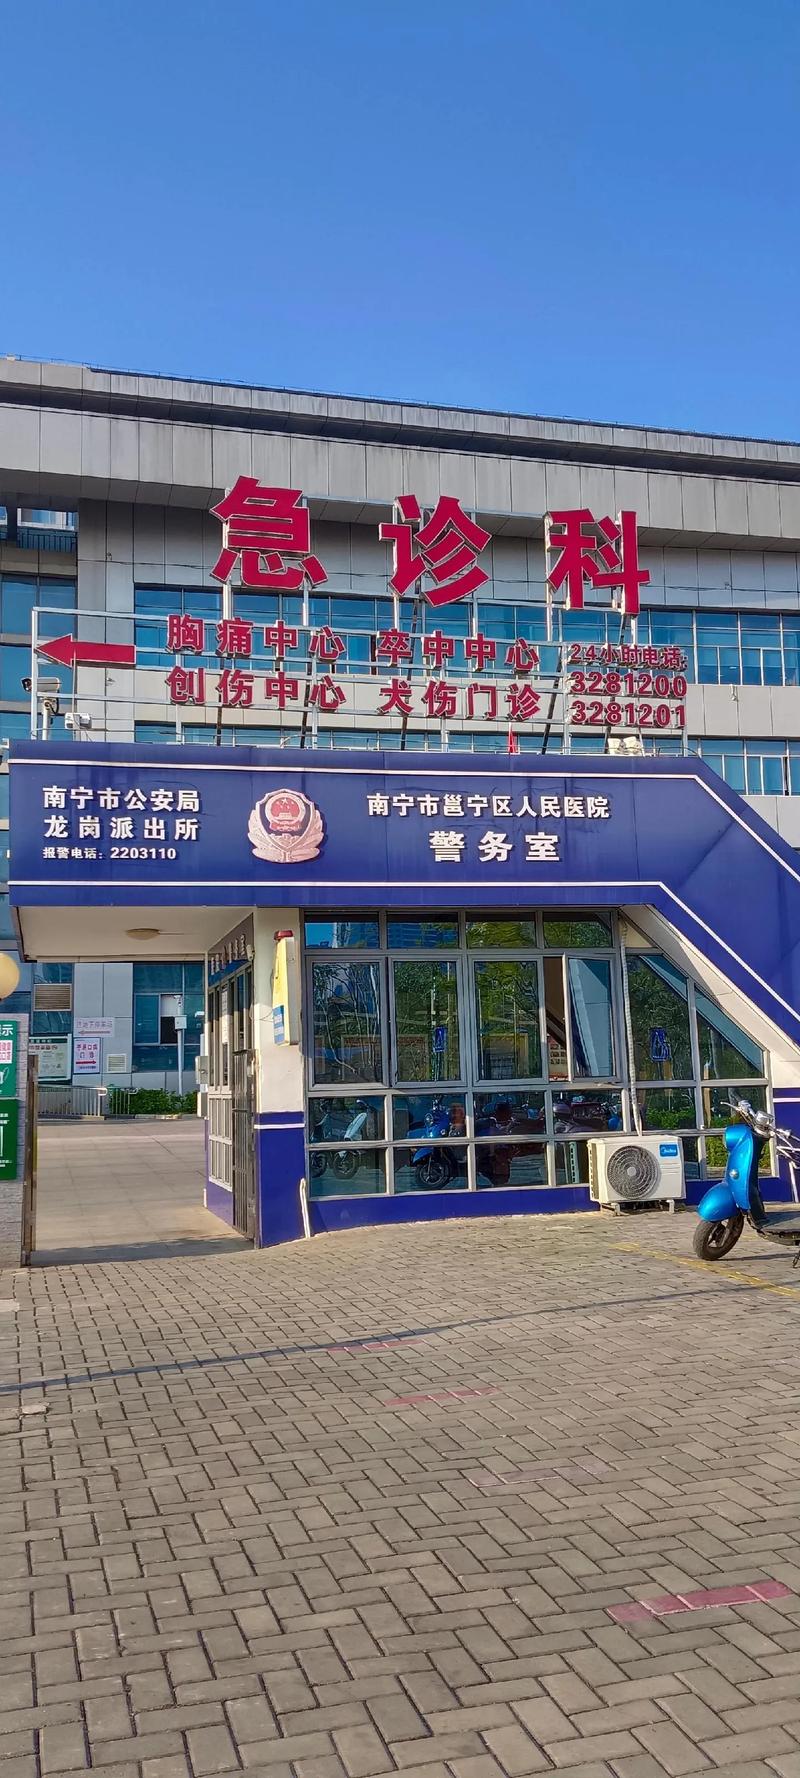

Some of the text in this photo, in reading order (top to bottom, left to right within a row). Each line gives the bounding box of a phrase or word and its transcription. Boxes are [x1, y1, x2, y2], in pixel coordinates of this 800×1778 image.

[209, 475, 652, 615] 急诊科
[165, 613, 541, 673] 胸痛中心 卒中中心
[165, 665, 541, 722] 创伤中心 犬伤门诊
[570, 670, 688, 699] 3281200
[570, 699, 686, 727] 3281201
[42, 785, 200, 812] 南宁市公安局
[366, 792, 611, 819] 南宁市邕宁区人民医院
[44, 816, 200, 841] 龙岗派出所
[428, 830, 561, 862] 警务室
[0, 1024, 13, 1037] 示
